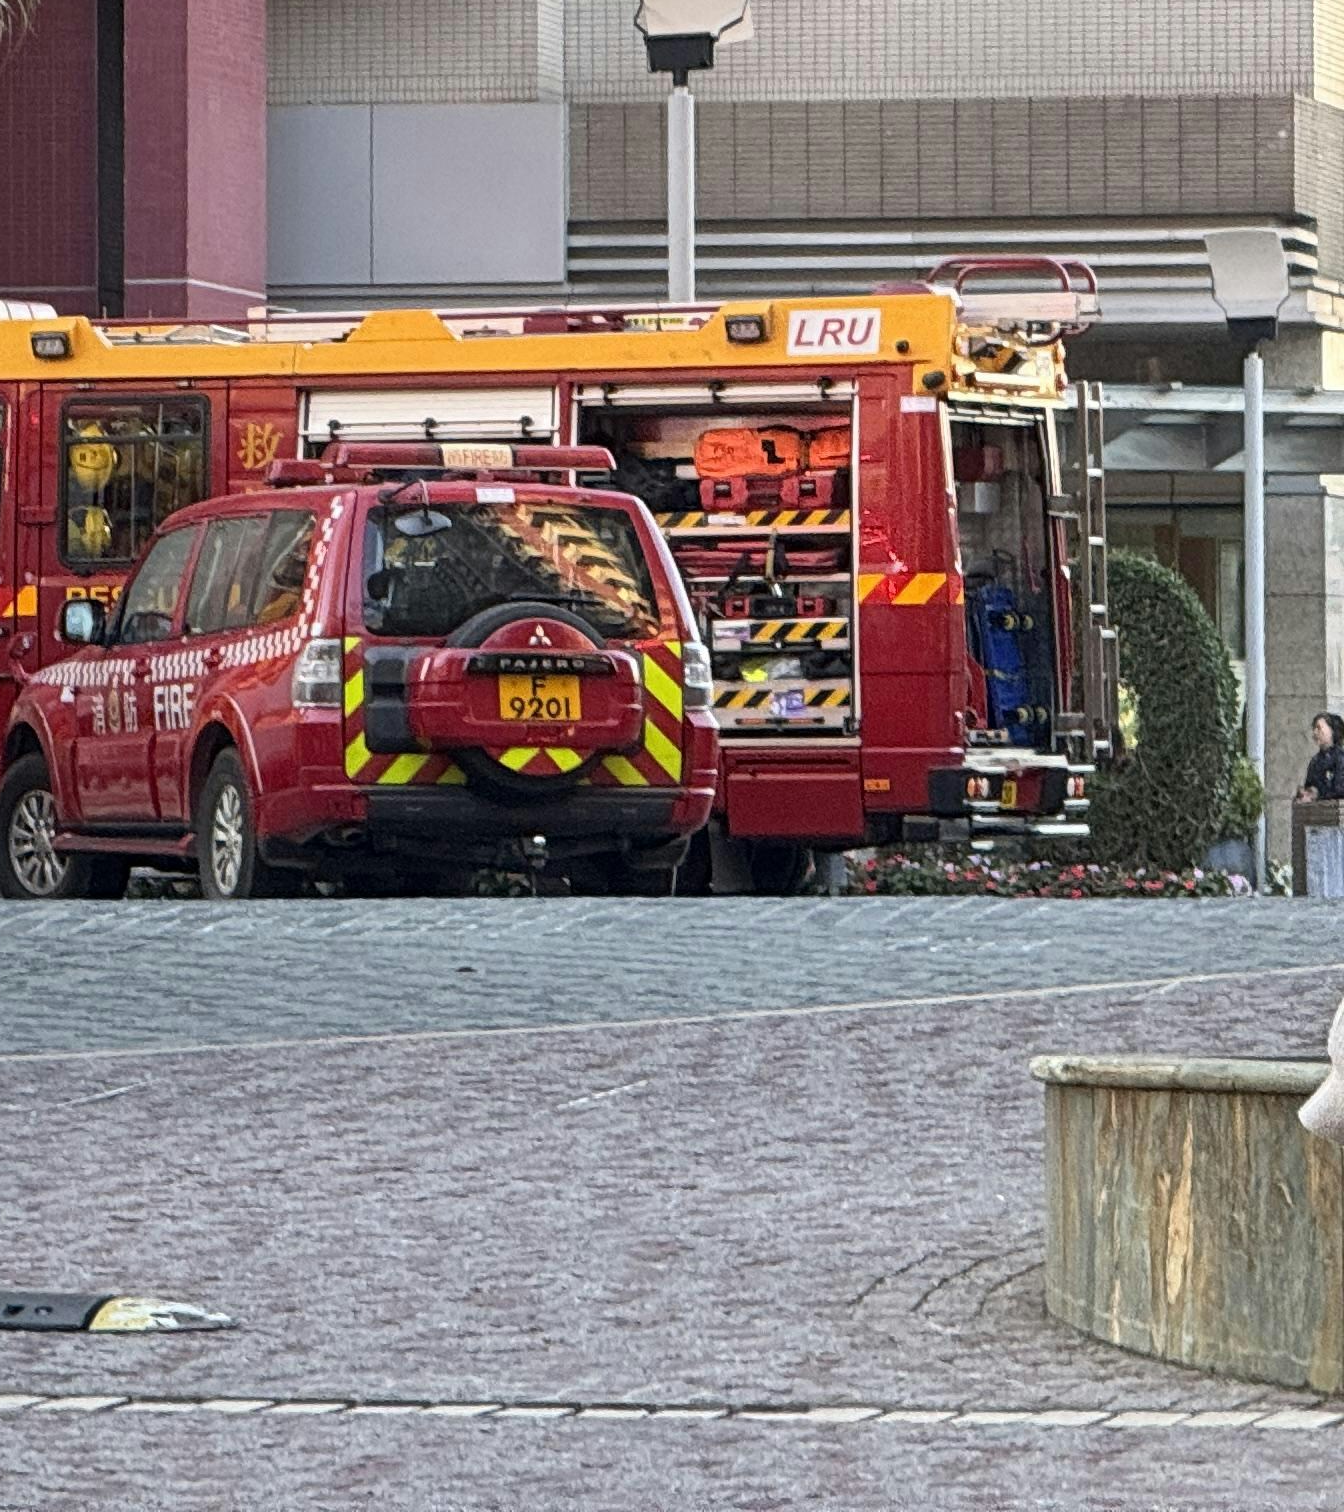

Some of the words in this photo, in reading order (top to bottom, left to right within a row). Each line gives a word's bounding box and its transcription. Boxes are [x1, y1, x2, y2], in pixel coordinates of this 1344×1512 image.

[794, 317, 874, 346] LRU
[236, 423, 284, 469] 救
[499, 657, 585, 669] PAJERO
[532, 675, 546, 696] F
[153, 683, 194, 731] FIRE
[509, 696, 570, 719] 9201
